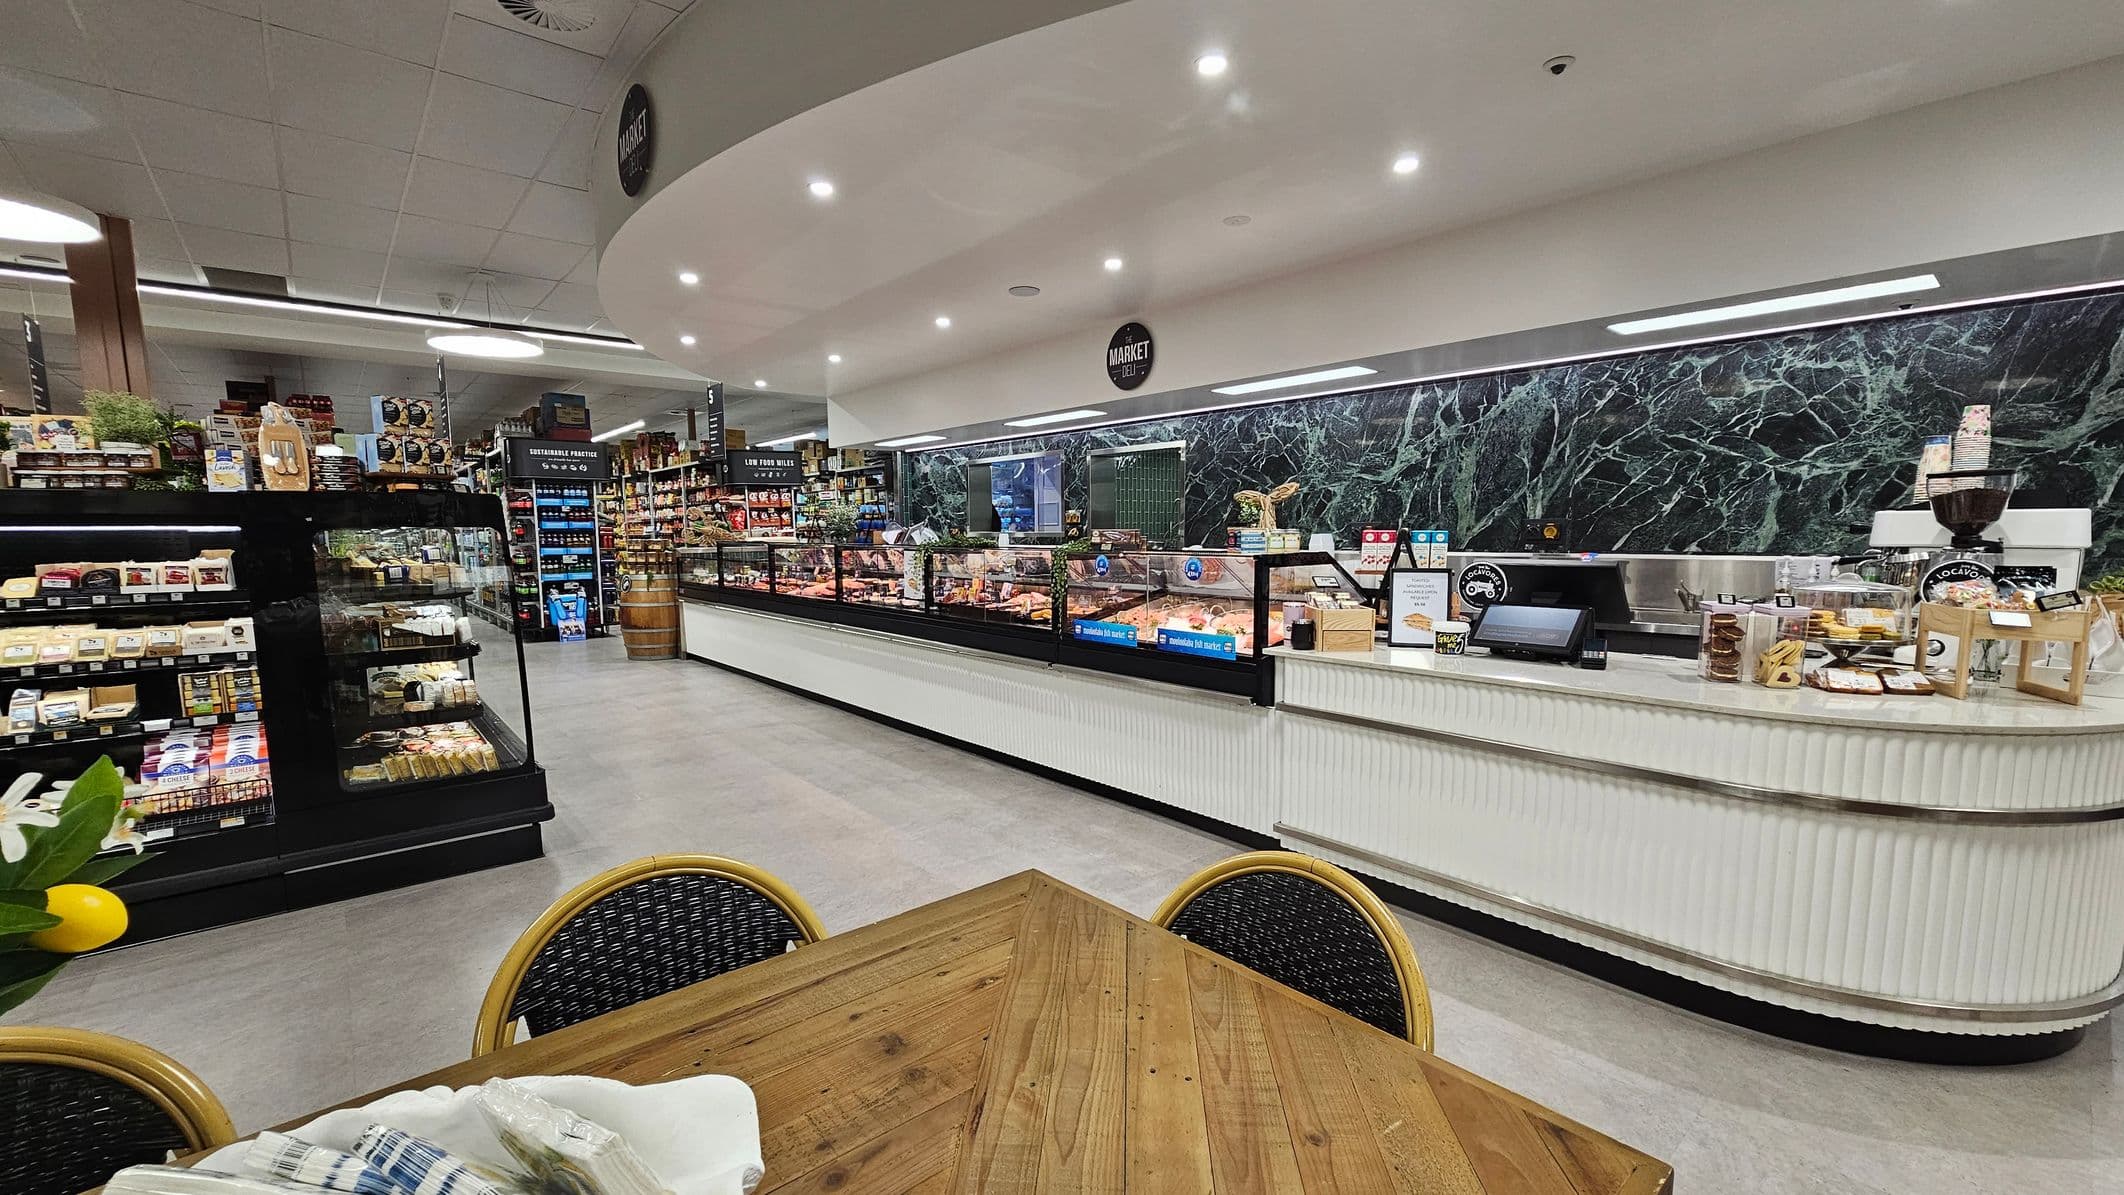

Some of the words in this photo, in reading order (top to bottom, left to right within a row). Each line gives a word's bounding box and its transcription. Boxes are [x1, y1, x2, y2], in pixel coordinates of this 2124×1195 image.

[619, 108, 647, 162] MARKET
[23, 320, 32, 342] 3
[1109, 340, 1150, 367] MARKET
[1122, 364, 1136, 378] DELI
[708, 389, 714, 405] 5
[529, 448, 569, 457] SUSTAINABLE
[570, 450, 598, 458] PRACTICE
[745, 458, 758, 466] LOW
[759, 459, 775, 467] FOOD
[776, 459, 795, 467] MILES
[1464, 569, 1502, 586] LOCAVORES
[1936, 567, 1985, 580] LOCAVO
[1194, 639, 1204, 649] fish
[1204, 641, 1222, 651] market
[1454, 633, 1465, 654] 5
[234, 765, 257, 774] CHEESE
[167, 774, 191, 783] CHEESE
